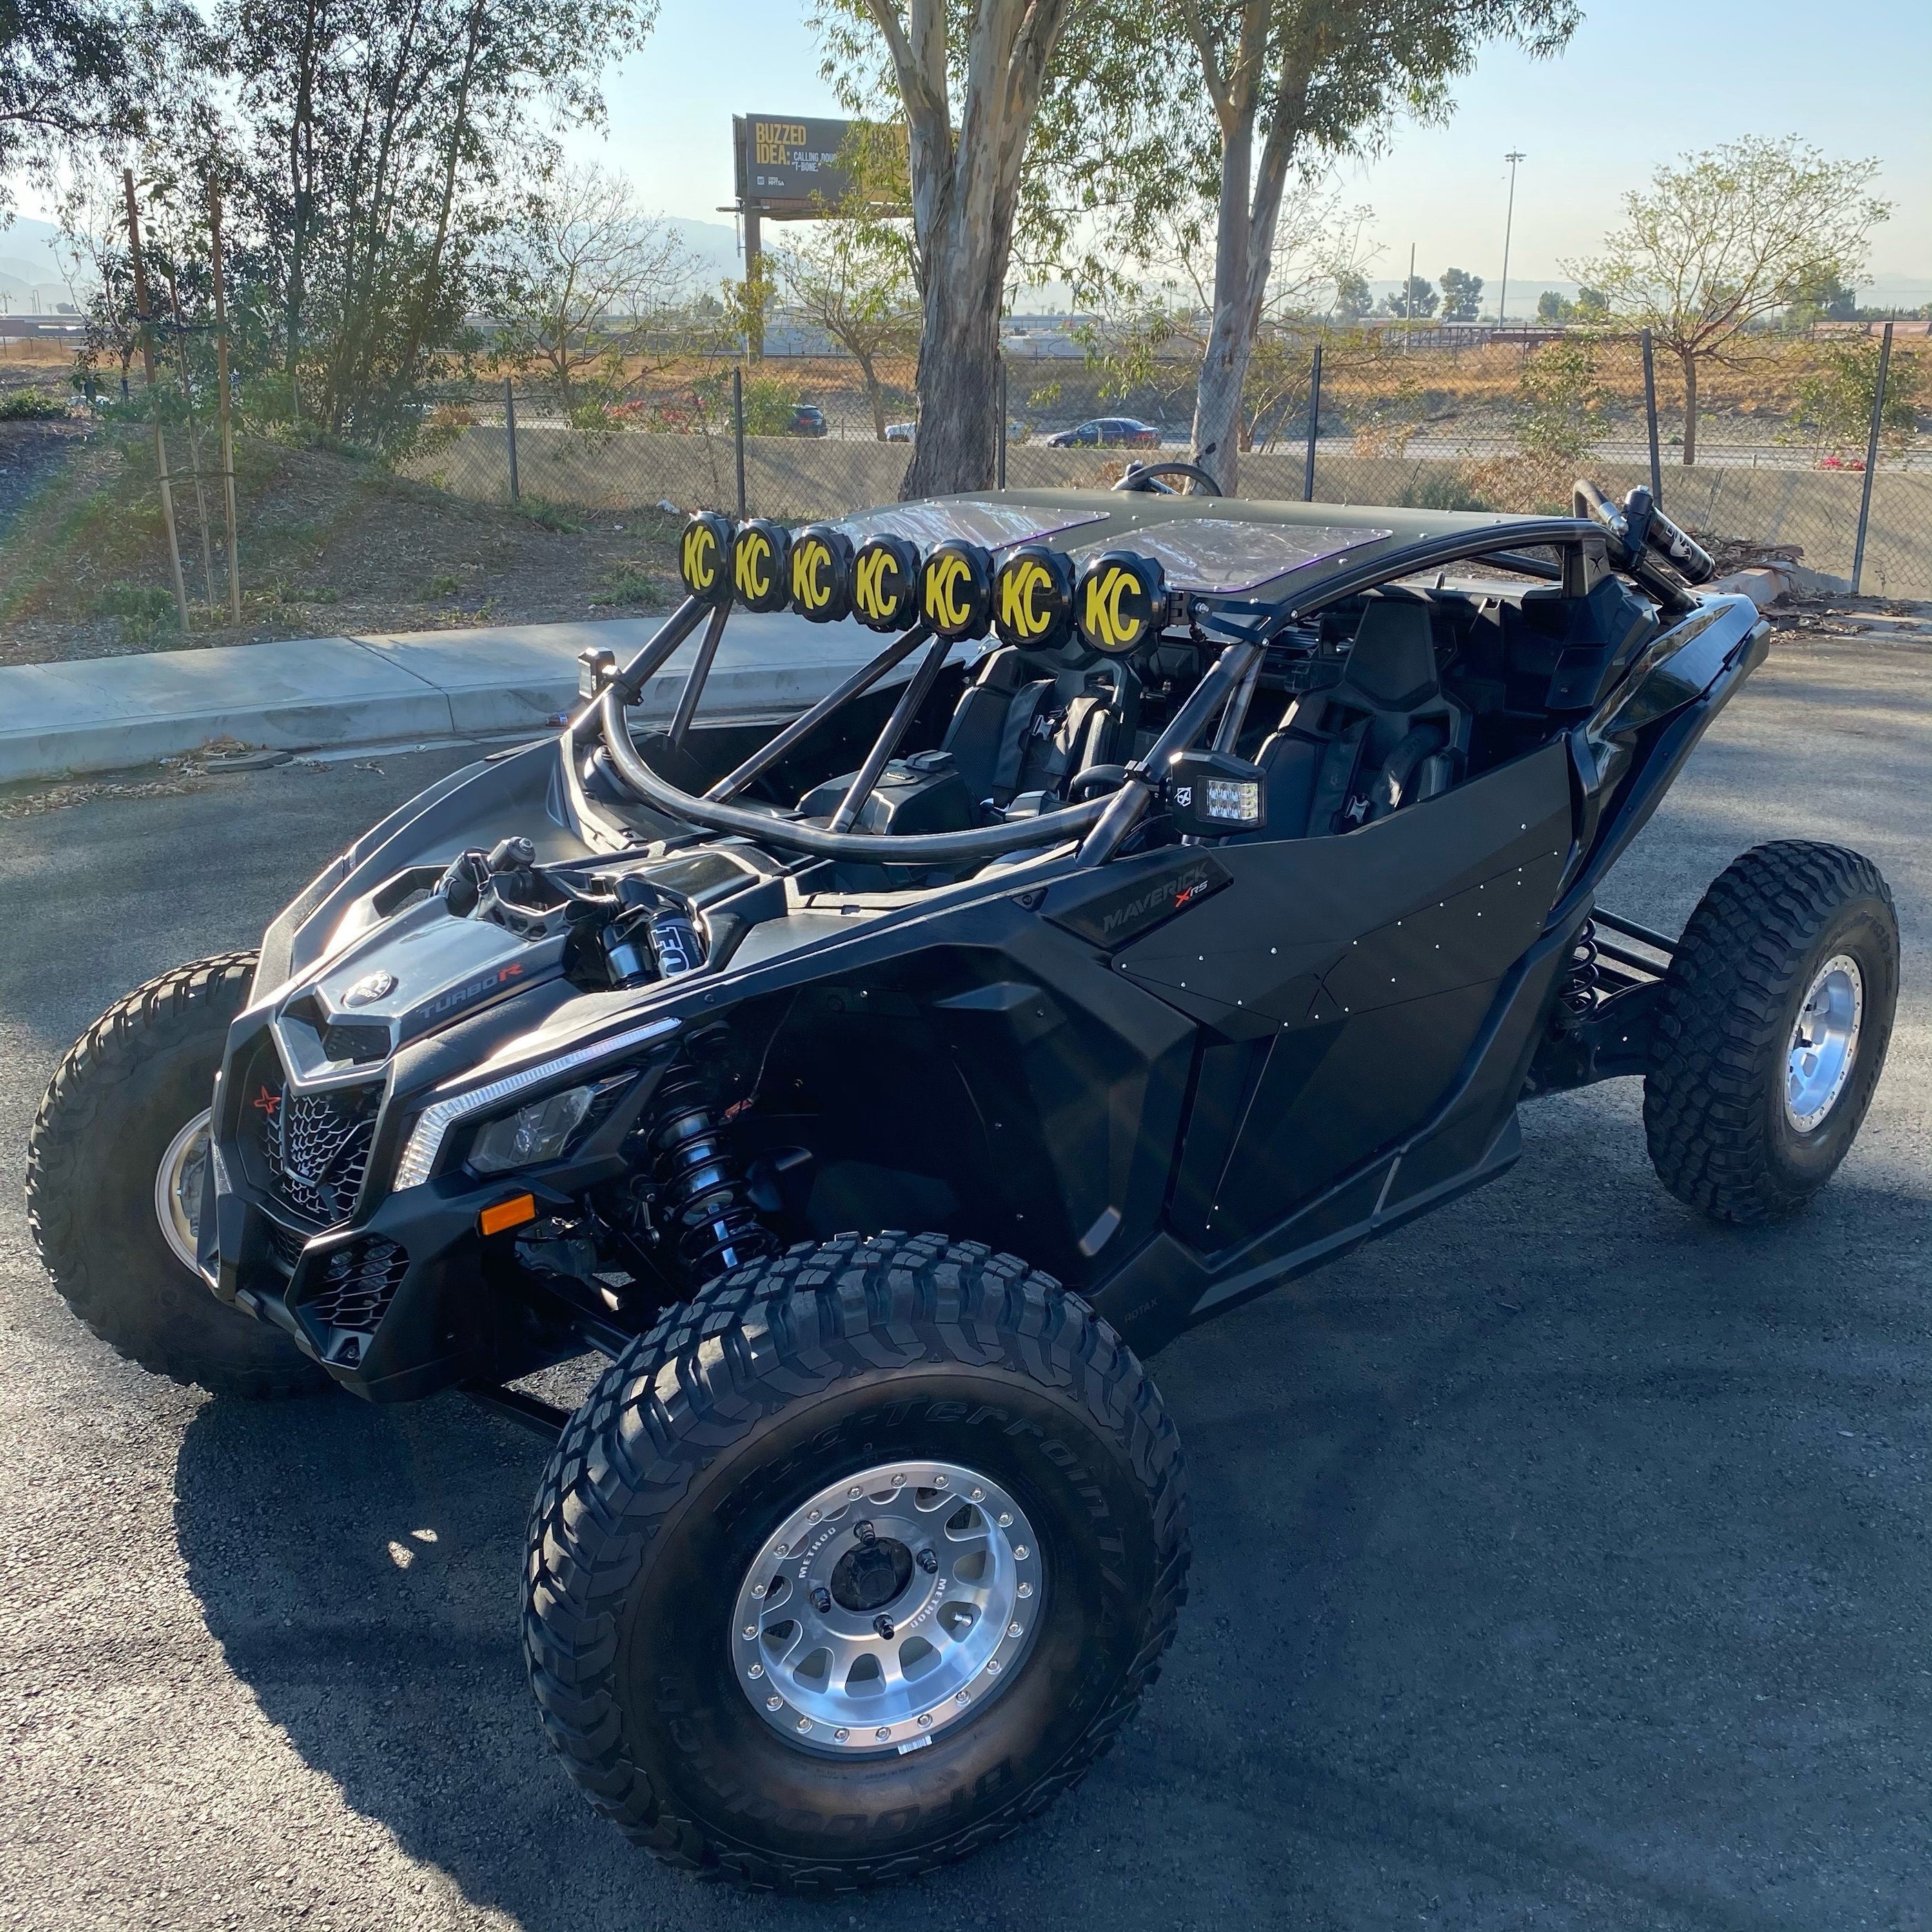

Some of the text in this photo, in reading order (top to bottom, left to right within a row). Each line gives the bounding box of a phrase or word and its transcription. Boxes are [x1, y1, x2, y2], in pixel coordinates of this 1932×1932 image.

[755, 122, 807, 146] BUZZED
[756, 144, 791, 165] IDEA:
[793, 151, 819, 162] CALLING
[684, 526, 715, 590] KC
[736, 533, 770, 600] KC
[793, 541, 831, 610] KC
[856, 549, 898, 619] KC
[926, 555, 971, 628] KC
[1002, 562, 1052, 637] KC
[1086, 567, 1141, 645] KC
[1103, 863, 1208, 933] MAVERICK
[651, 927, 691, 979] FO
[357, 987, 377, 998] BRP
[798, 1526, 837, 1579] METHOD
[909, 1578, 947, 1629] METHOD
